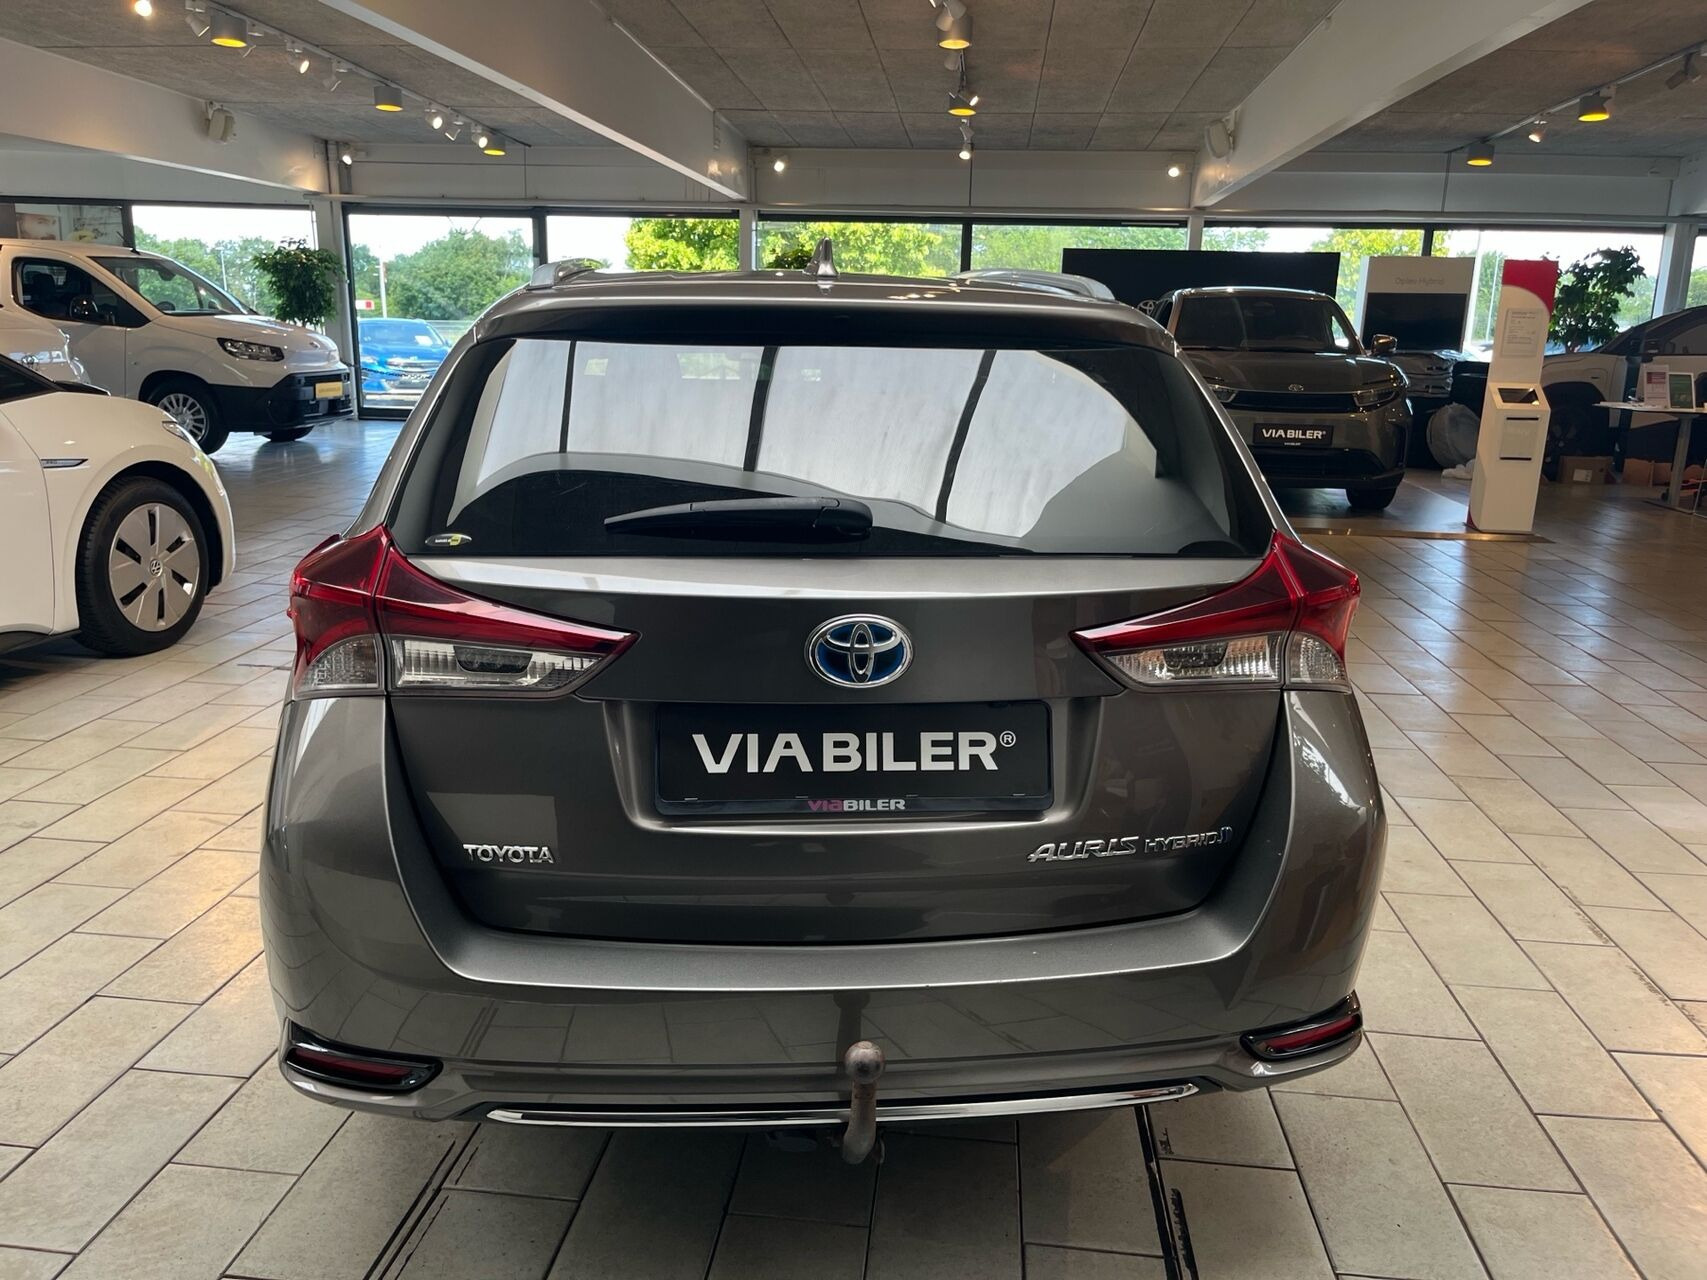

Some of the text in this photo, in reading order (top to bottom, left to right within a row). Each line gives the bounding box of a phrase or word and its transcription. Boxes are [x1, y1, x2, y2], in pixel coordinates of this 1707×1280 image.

[1262, 428, 1286, 438] VIA
[692, 732, 814, 774] VIA
[462, 843, 554, 864] TOYOTA
[1027, 835, 1140, 863] AURIS
